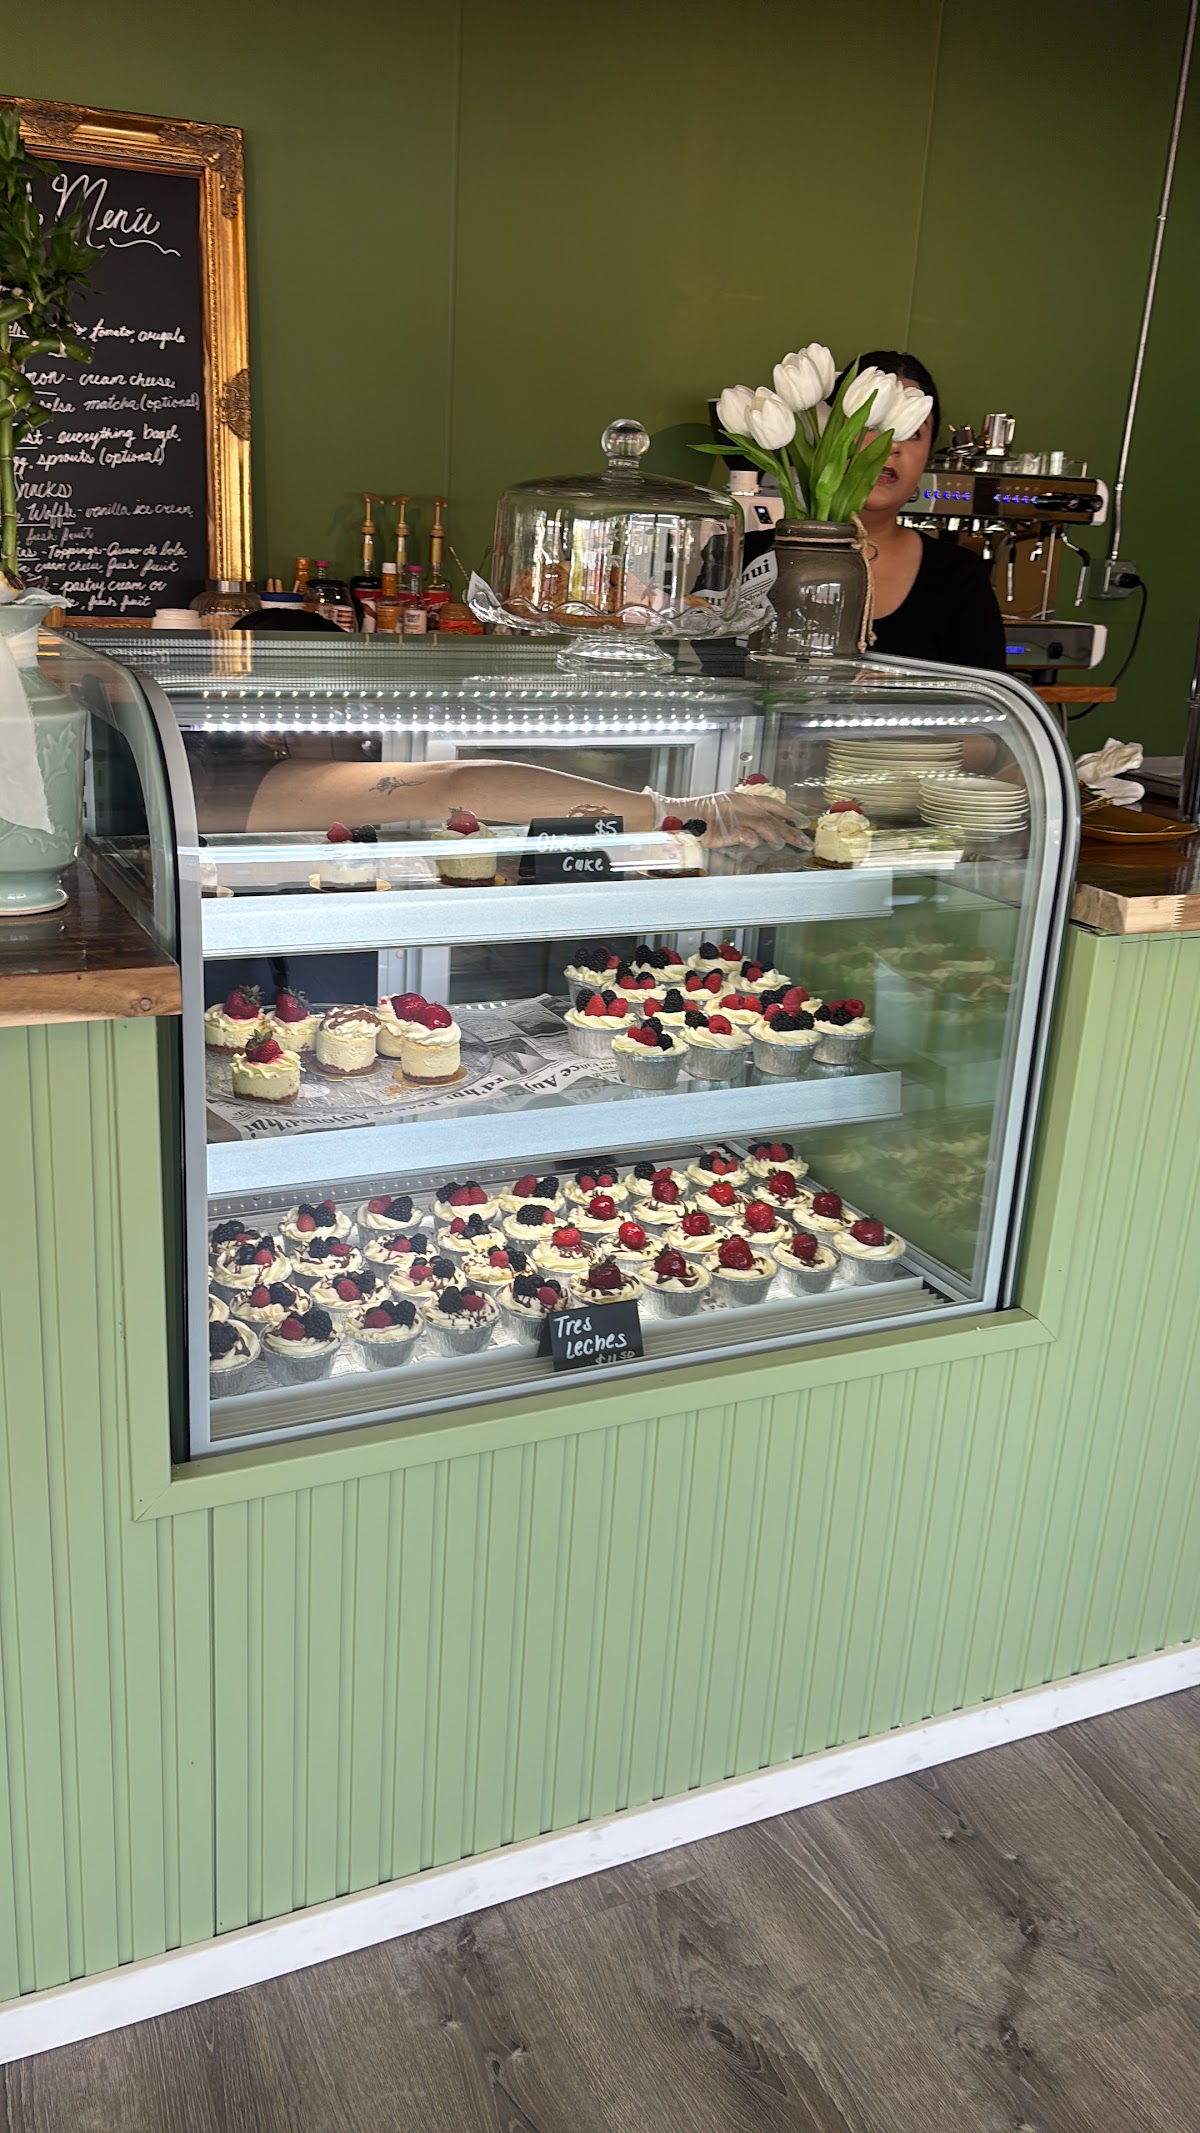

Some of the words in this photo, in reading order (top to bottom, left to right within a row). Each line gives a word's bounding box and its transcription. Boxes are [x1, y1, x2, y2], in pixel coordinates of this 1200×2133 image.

[79, 371, 127, 386] cream
[83, 394, 140, 412] matcha
[140, 393, 200, 412] (optional)
[56, 426, 137, 449] everything
[36, 449, 95, 471] sprouts
[99, 447, 165, 469] (optional)
[26, 502, 77, 529] Waffle
[85, 502, 131, 518] vanilla
[131, 499, 154, 515] ice
[142, 543, 158, 556] de
[34, 562, 67, 573] cream
[140, 558, 179, 578] fruit
[60, 577, 106, 599] pastry
[107, 581, 146, 592] cream
[149, 580, 168, 592] or
[594, 819, 617, 836] $5
[562, 856, 604, 872] Cake
[553, 1315, 592, 1338] Tres
